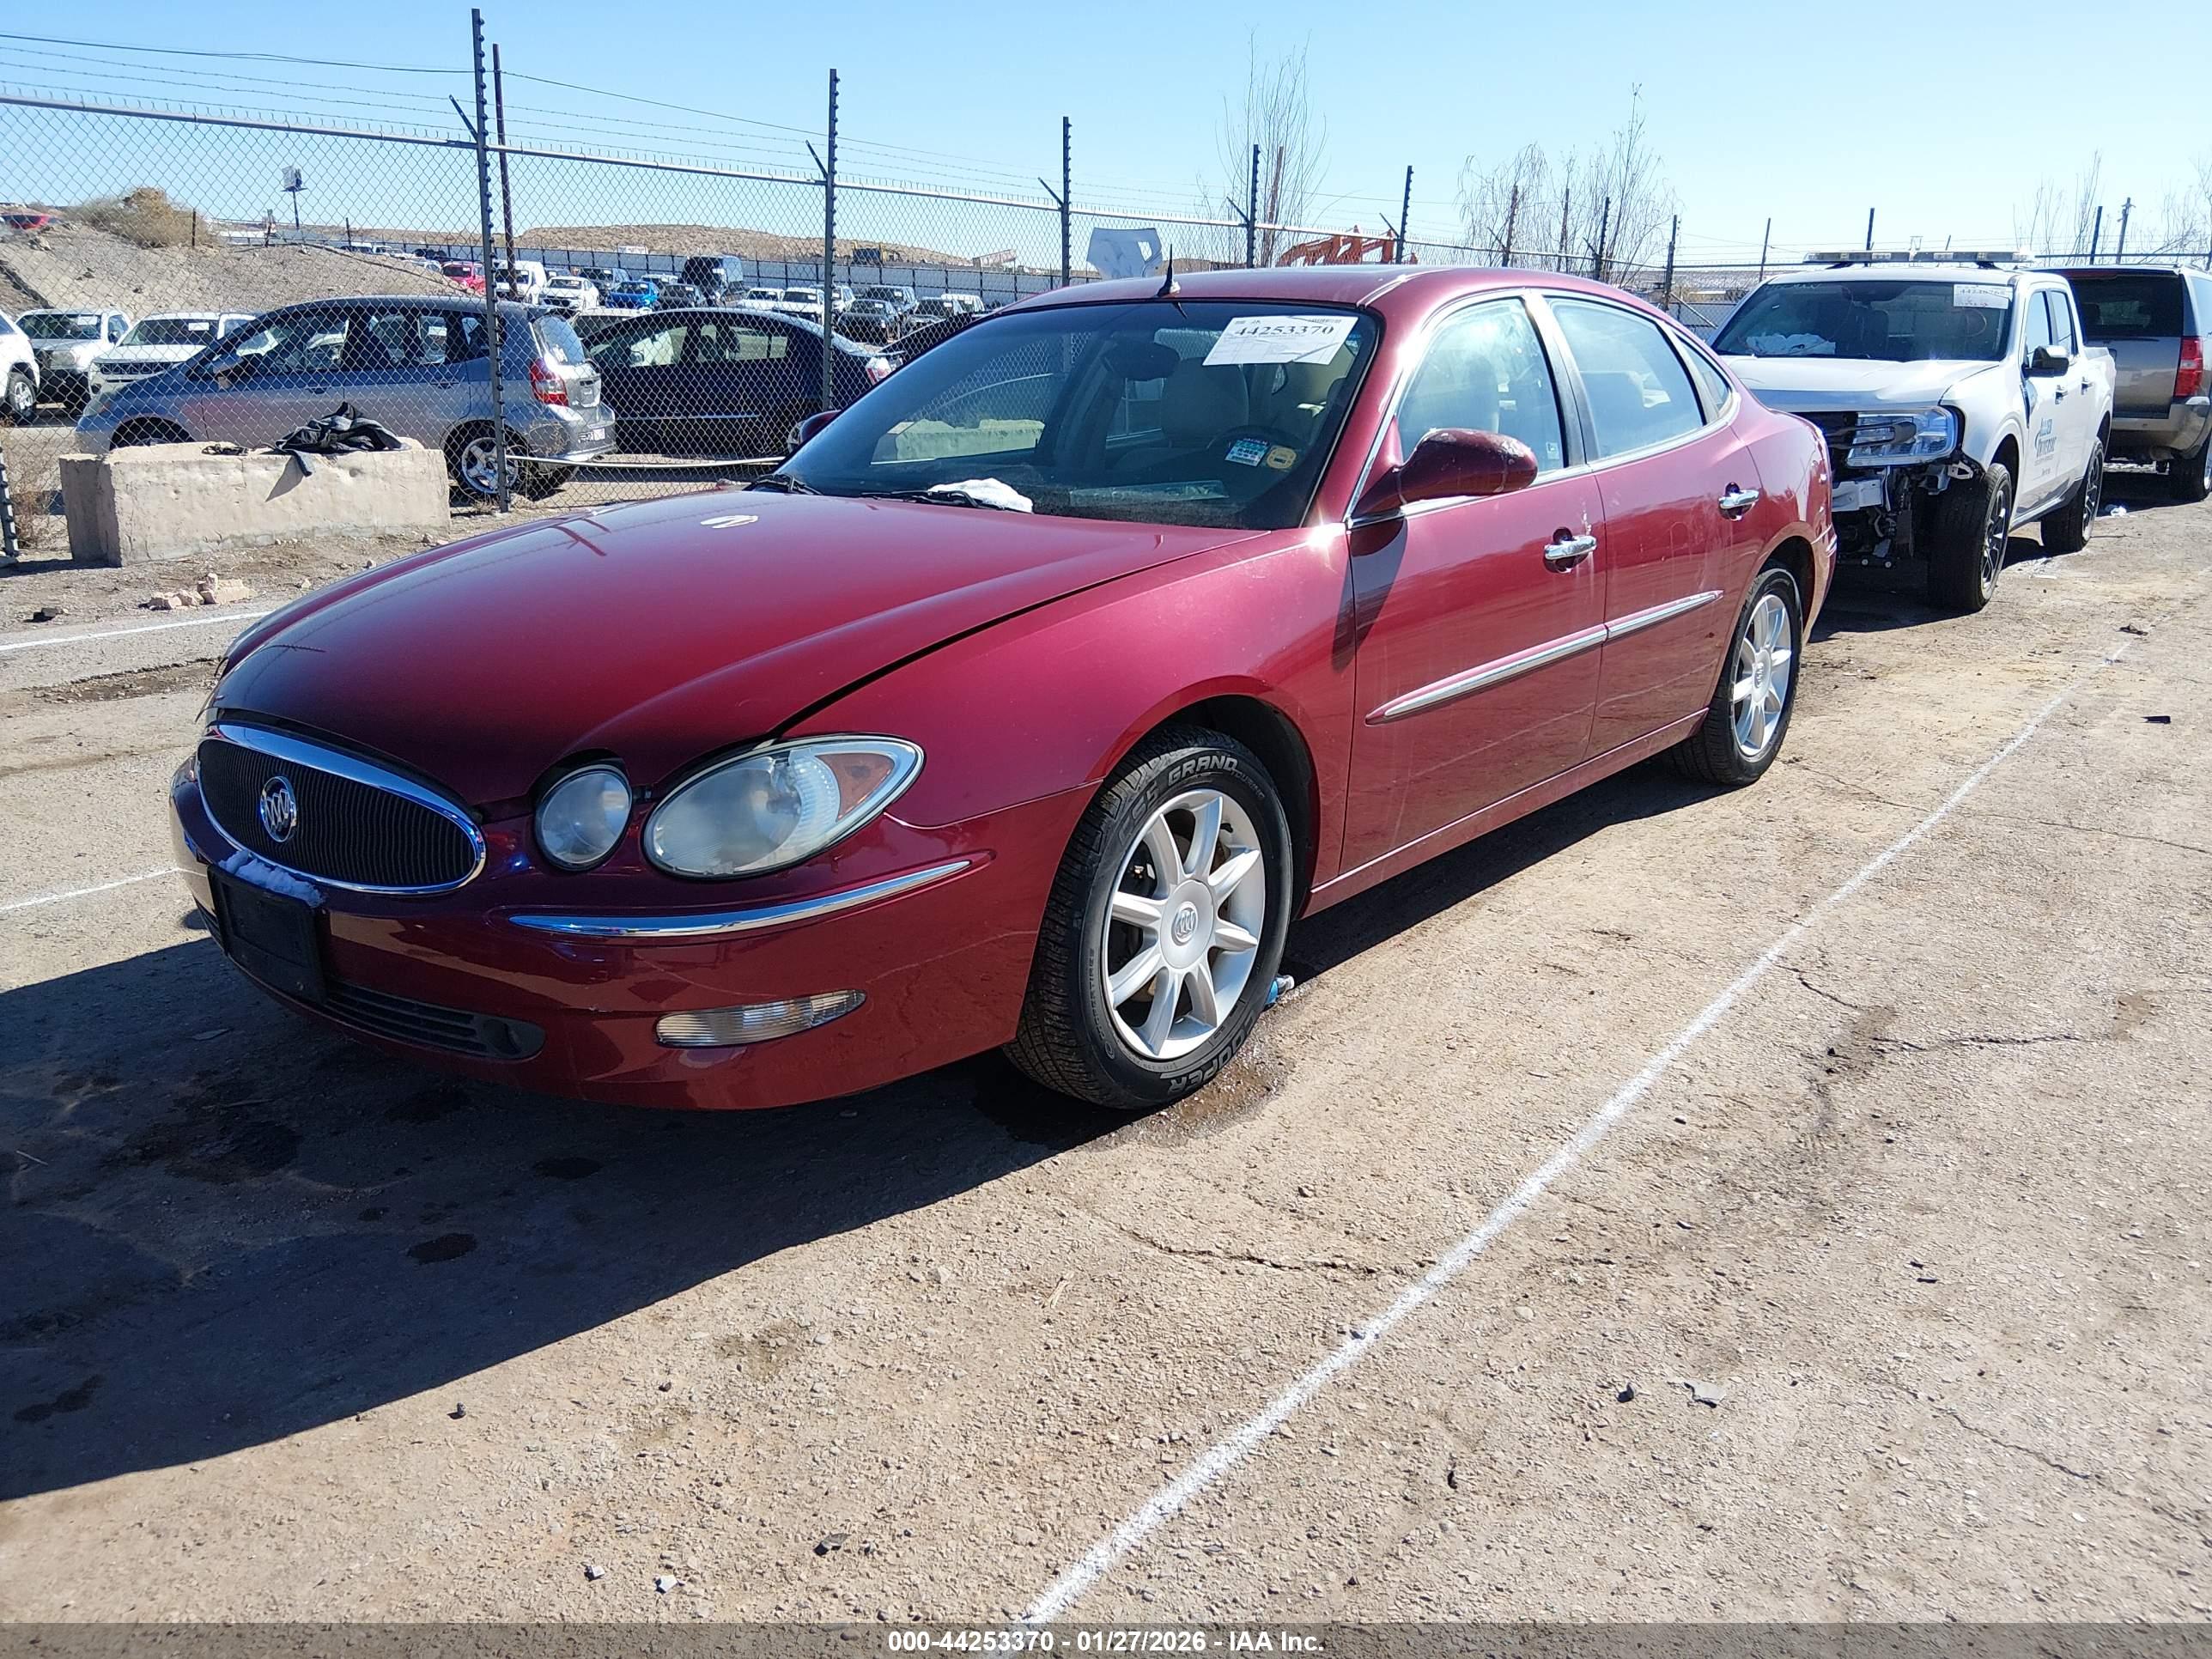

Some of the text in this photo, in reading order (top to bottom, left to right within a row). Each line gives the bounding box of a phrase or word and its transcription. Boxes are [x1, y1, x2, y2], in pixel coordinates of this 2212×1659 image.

[1235, 325, 1334, 336] 44253370
[1168, 756, 1237, 787] GRAND
[1167, 1009, 1255, 1095] COOPER
